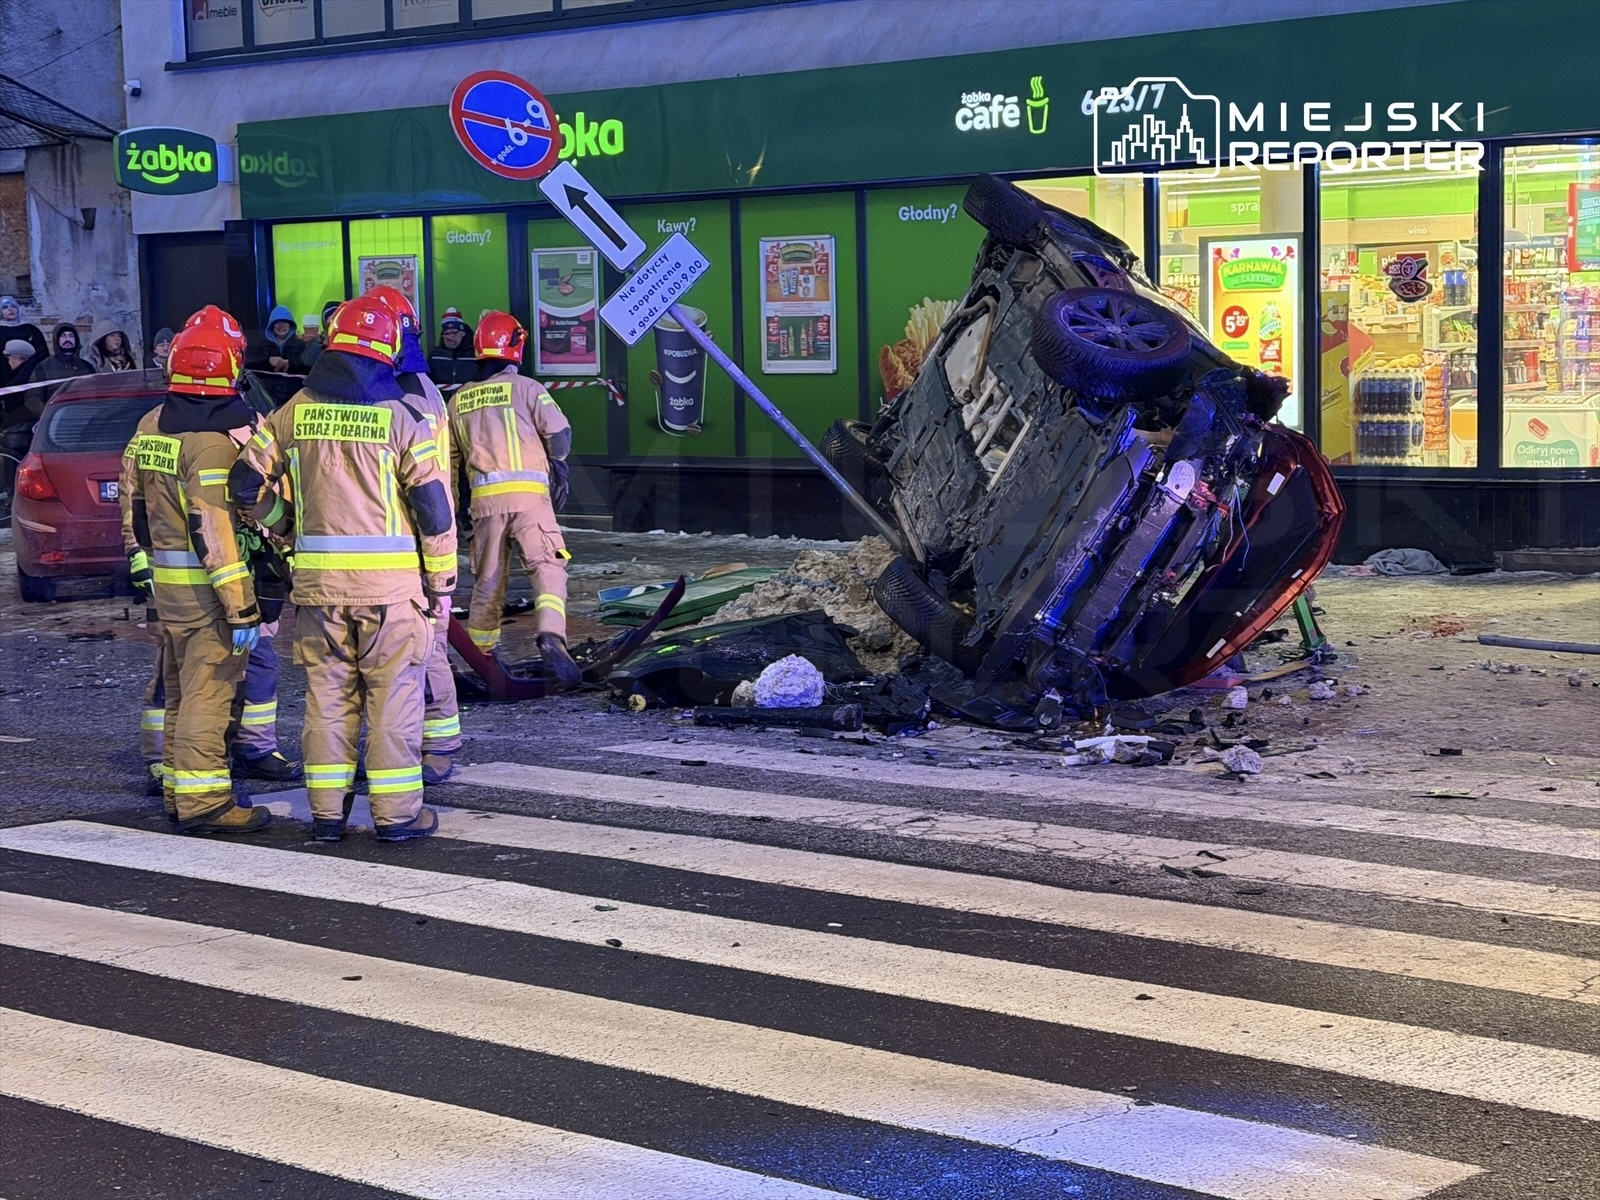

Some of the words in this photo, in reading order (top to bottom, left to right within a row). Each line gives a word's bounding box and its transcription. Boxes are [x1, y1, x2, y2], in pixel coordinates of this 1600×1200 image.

[556, 112, 624, 159] bka
[126, 142, 212, 173] żabka
[898, 203, 958, 224] Głodny?
[657, 217, 697, 235] Kawy?
[446, 229, 492, 247] Głodny?
[618, 285, 637, 303] Nie
[636, 252, 670, 286] dotyczy
[628, 260, 682, 317] zaopatrzenia
[365, 313, 375, 325] 8
[402, 316, 410, 328] 8
[628, 327, 638, 338] w
[638, 306, 662, 330] godz.
[669, 396, 694, 406] żabka
[303, 406, 379, 425] PAŃSTWOWA
[295, 422, 330, 437] STRAŻ
[332, 424, 386, 440] POŻARNA
[1517, 445, 1548, 456] Odkryj
[1551, 447, 1576, 455] nowe
